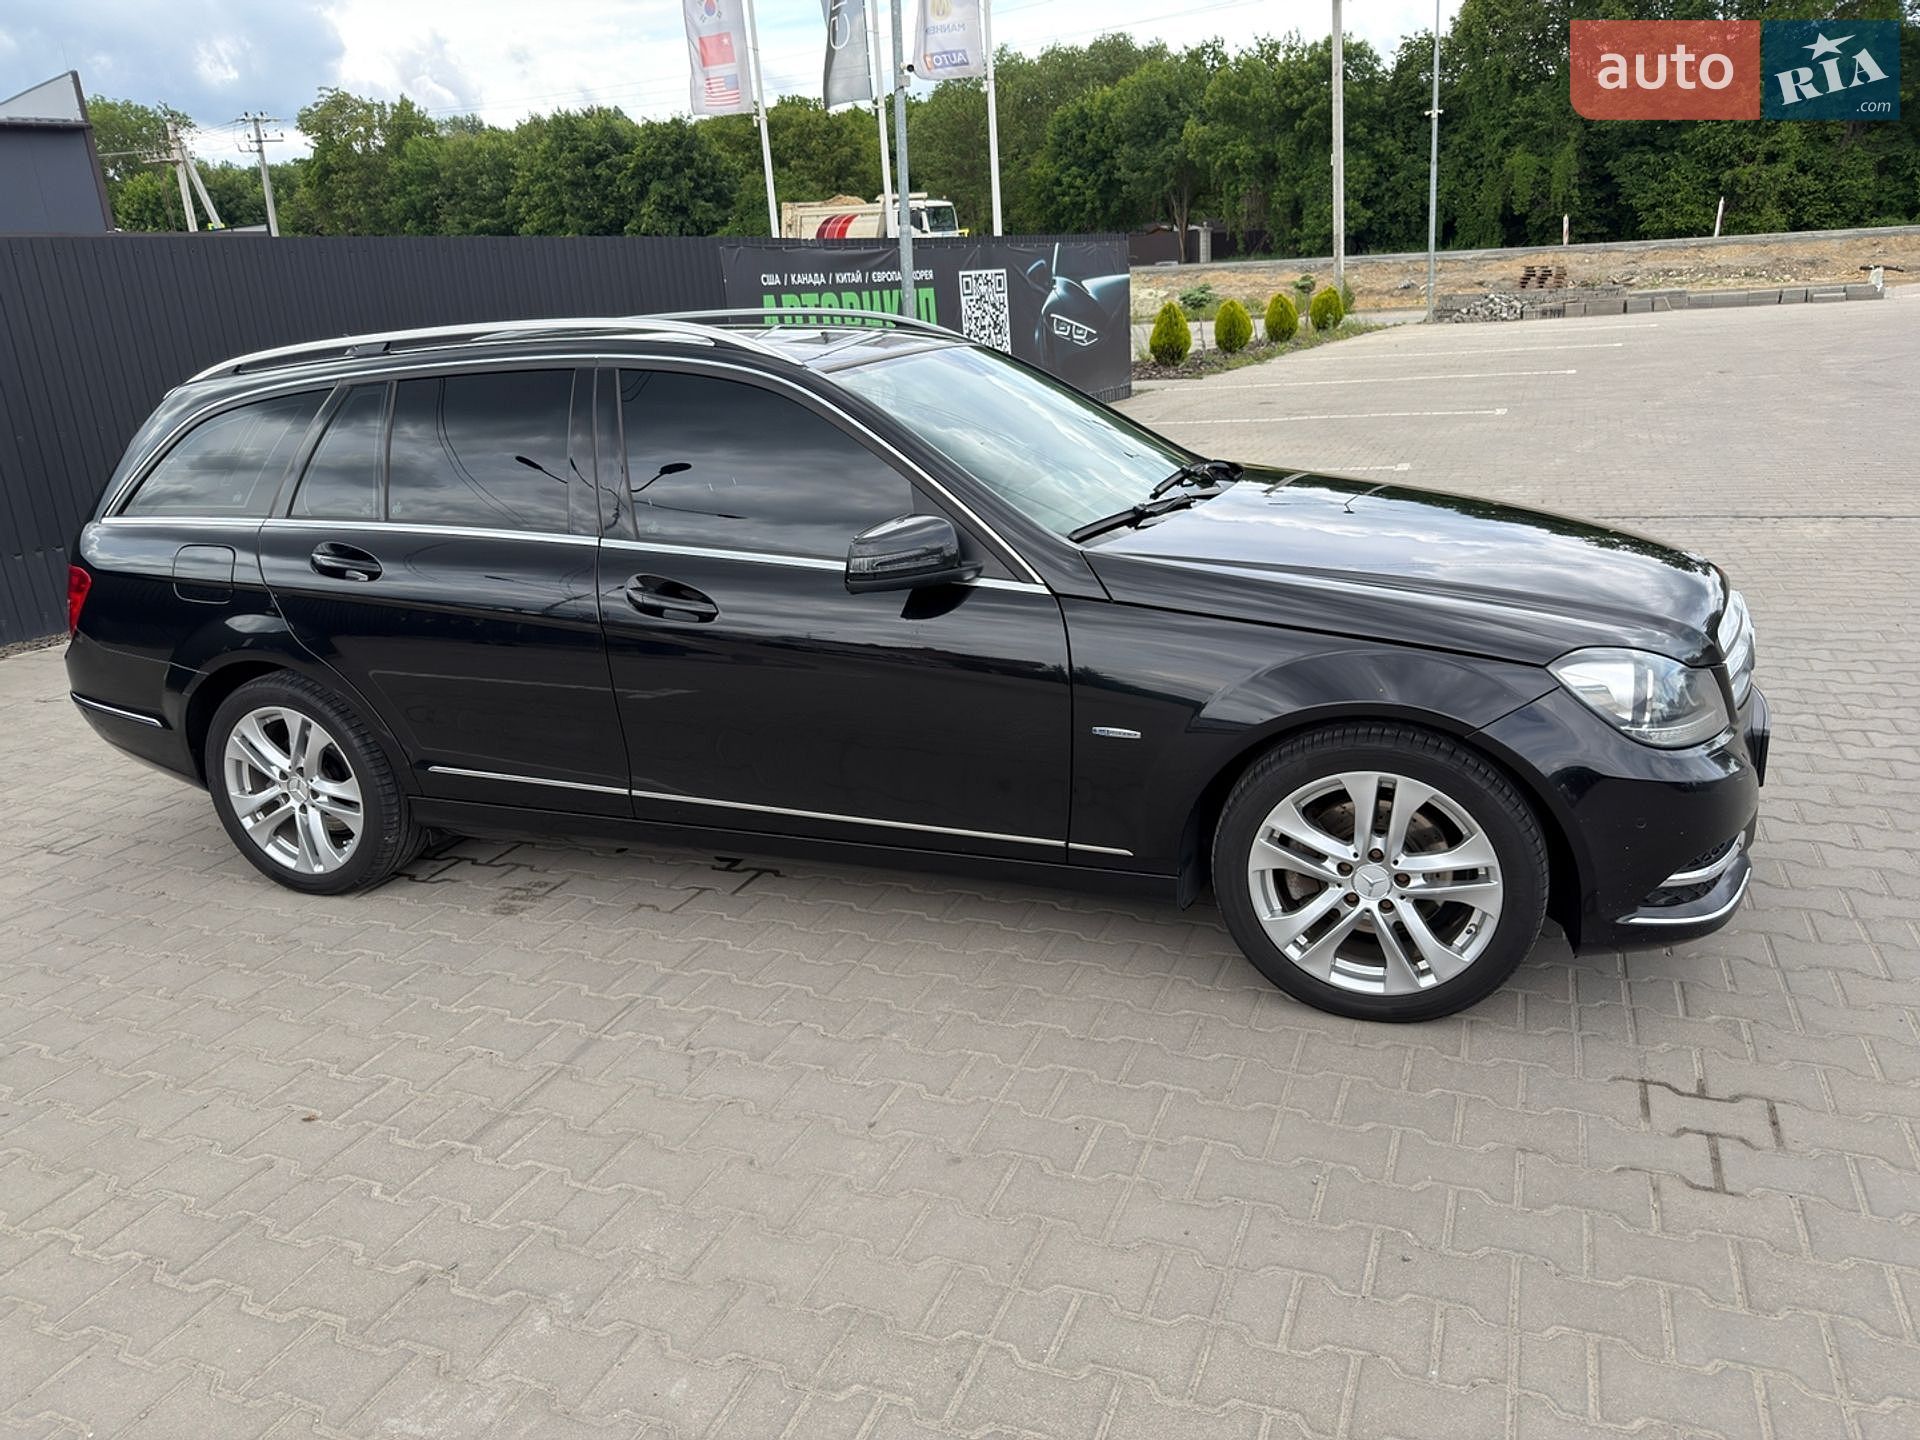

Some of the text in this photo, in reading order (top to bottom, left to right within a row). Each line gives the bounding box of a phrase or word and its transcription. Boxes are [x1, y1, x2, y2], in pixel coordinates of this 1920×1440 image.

[761, 273, 781, 286] США
[790, 272, 826, 286] КАНАДА
[836, 270, 863, 284] КИТАЙ
